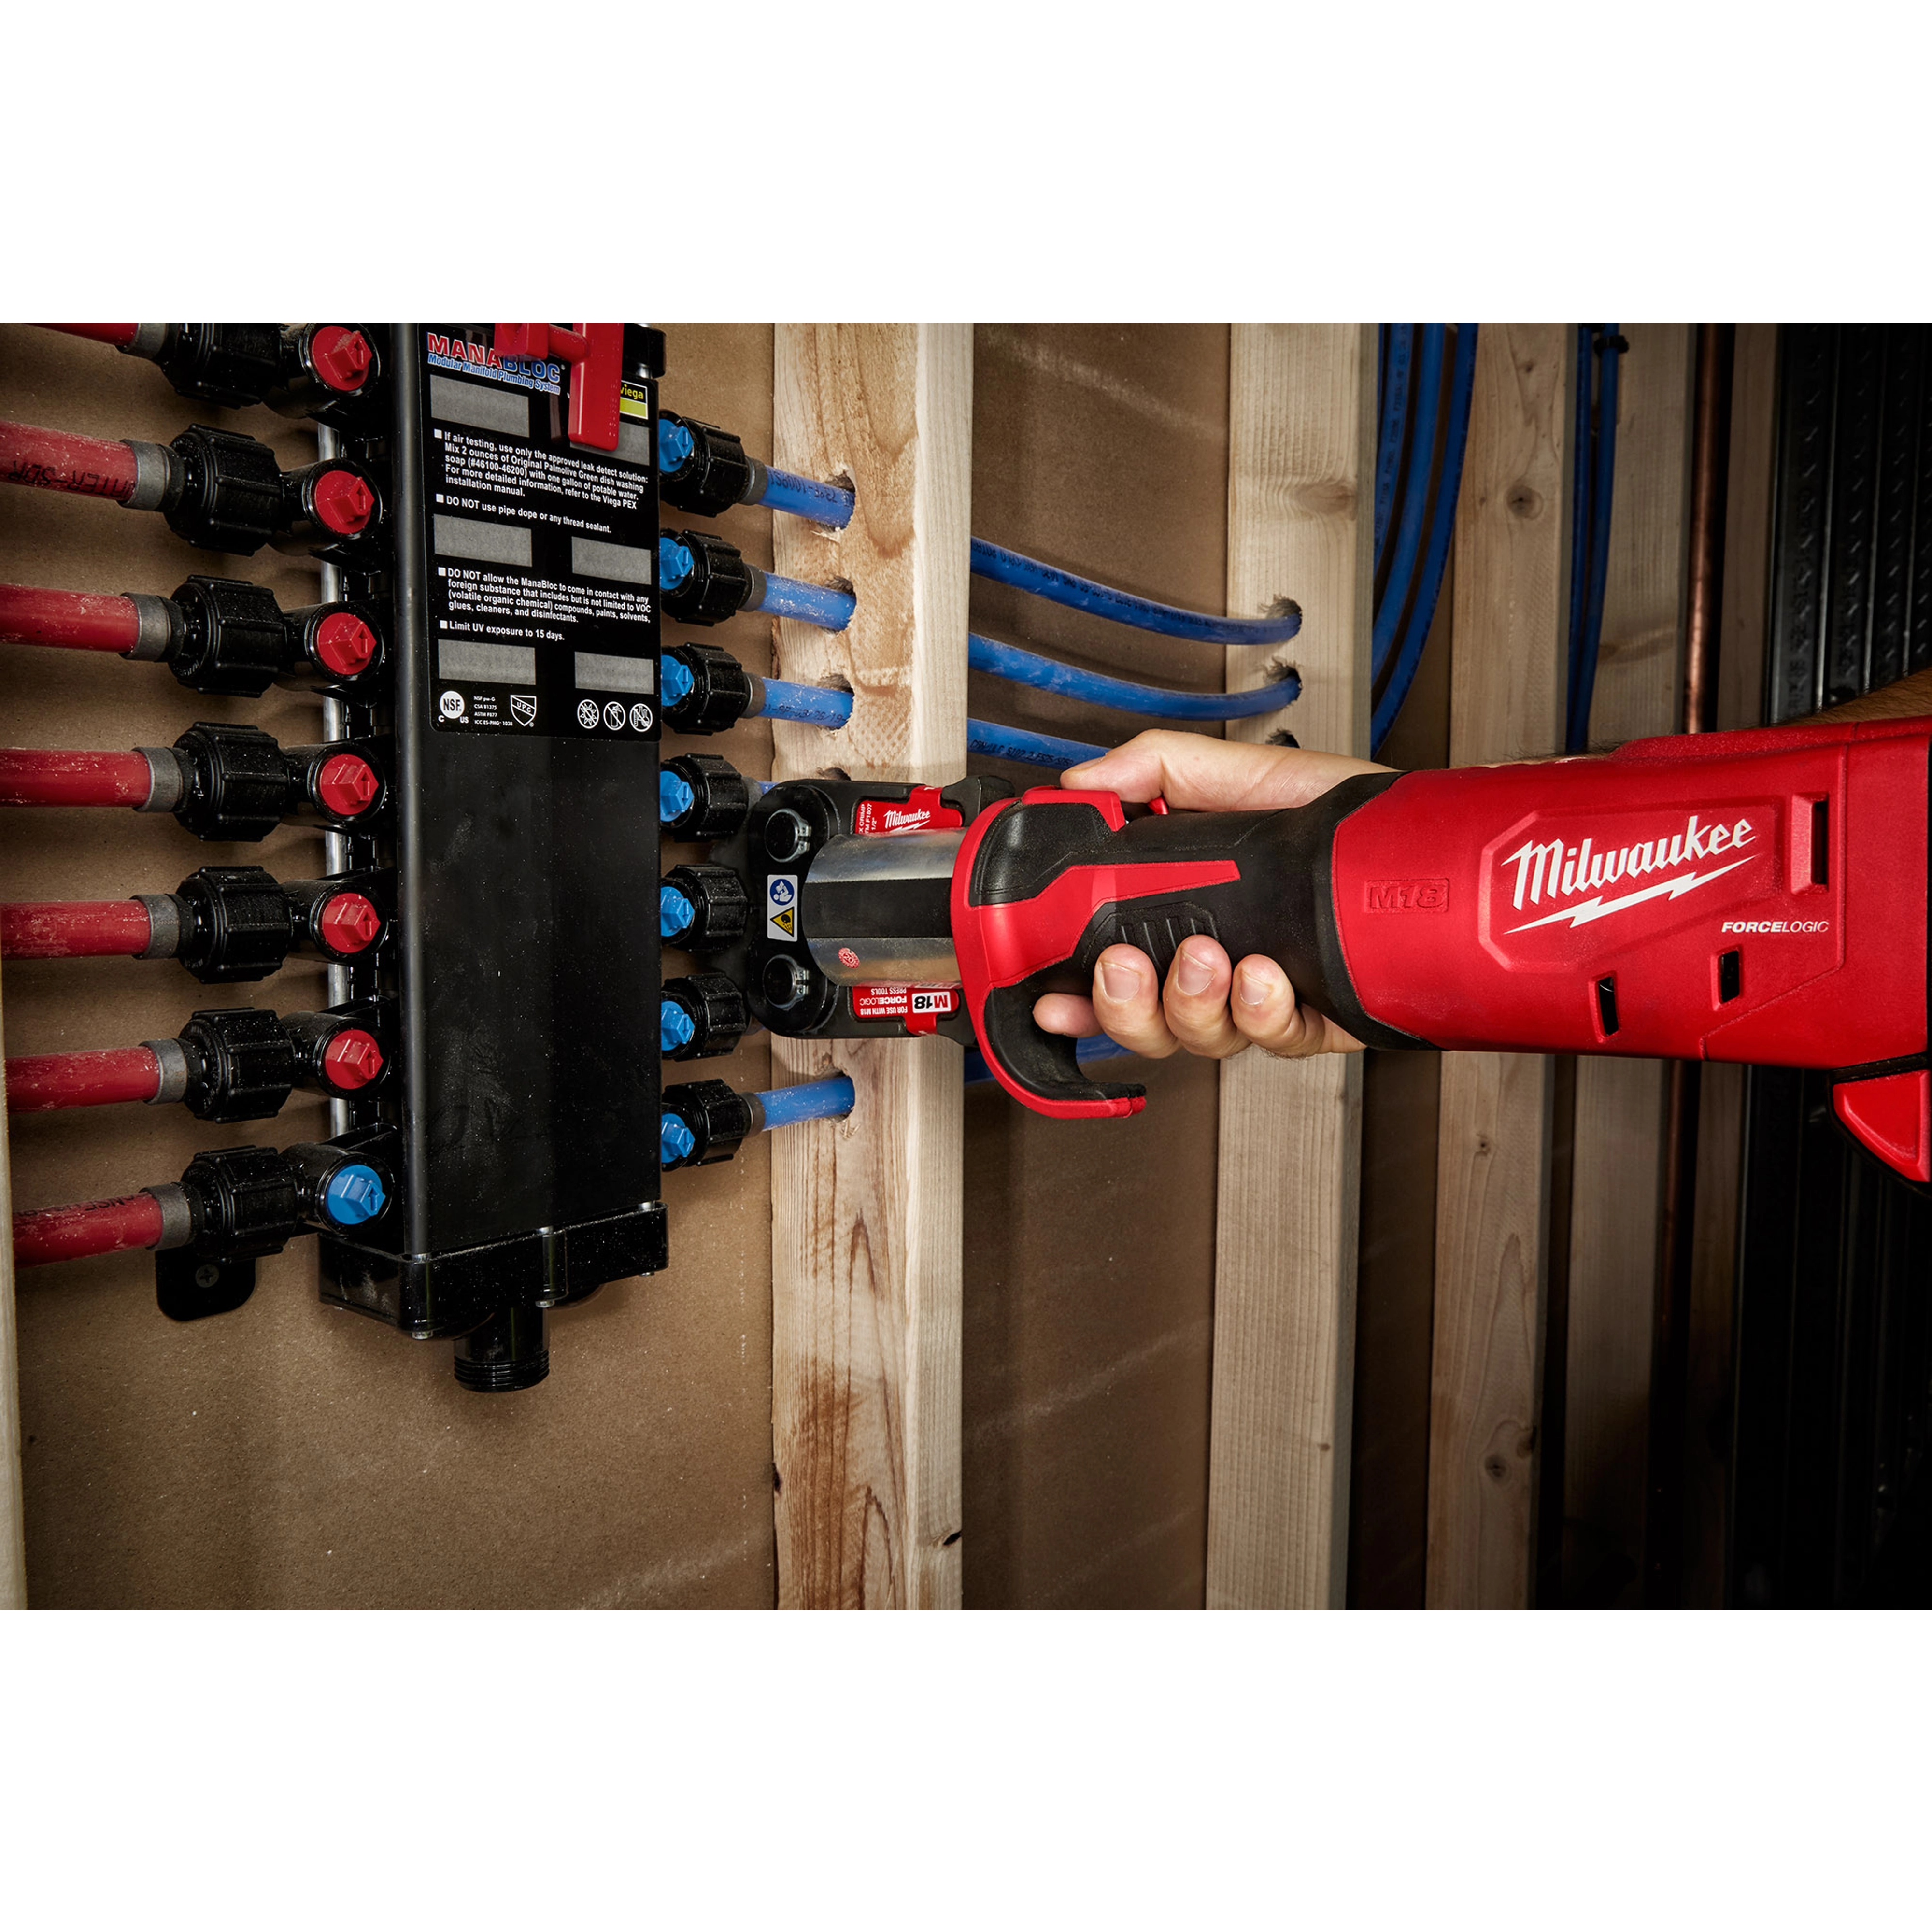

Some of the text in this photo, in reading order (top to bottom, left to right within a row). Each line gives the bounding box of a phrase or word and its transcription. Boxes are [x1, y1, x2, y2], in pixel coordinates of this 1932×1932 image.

[427, 353, 561, 395] Modular Manifold Plumbing System
[620, 384, 644, 400] viega
[444, 431, 648, 483] If air testing, use only the approved leak detect solution:
[445, 442, 643, 494] Mix 2 ounces of Original Palmolive Green dish washing
[445, 455, 639, 500] soap (#46100-46200) with one gallon of potable water.
[445, 464, 637, 510] For more detailed information, refer to the Viega PEX
[446, 475, 525, 497] installation manual.
[446, 495, 459, 506] DO
[462, 498, 480, 509] NOT
[482, 503, 497, 512] use
[498, 505, 516, 516] pipe
[518, 508, 538, 520] dope
[549, 514, 562, 525] any
[563, 516, 584, 528] thread
[585, 522, 611, 533] sealant.
[448, 568, 649, 605] DO NOT allow the ManaBloc to come in contact with any
[448, 579, 477, 592] foreign
[480, 584, 521, 596] substance
[523, 588, 539, 598] that
[540, 590, 569, 602] includes
[570, 594, 582, 604] but
[583, 596, 589, 605] is
[603, 599, 625, 610] limited
[627, 603, 635, 611] to
[635, 603, 651, 613] VOC
[448, 590, 651, 623] (volatile organic chemical) compounds, paints, solvents,
[449, 601, 579, 623] glues, cleaners, and disinfectants.
[449, 620, 565, 641] Limit UV exposure to 15 days.
[443, 698, 460, 711] NSF
[516, 702, 532, 713] UPC
[883, 808, 931, 829] Milwaukee
[1501, 815, 1756, 911] Milwaukee
[1369, 881, 1447, 910] M18
[1721, 920, 1829, 934] FORCELOGIC
[859, 996, 907, 1005] FORCELOGIC
[897, 1006, 908, 1014] FOR
[914, 995, 948, 1009] M18
